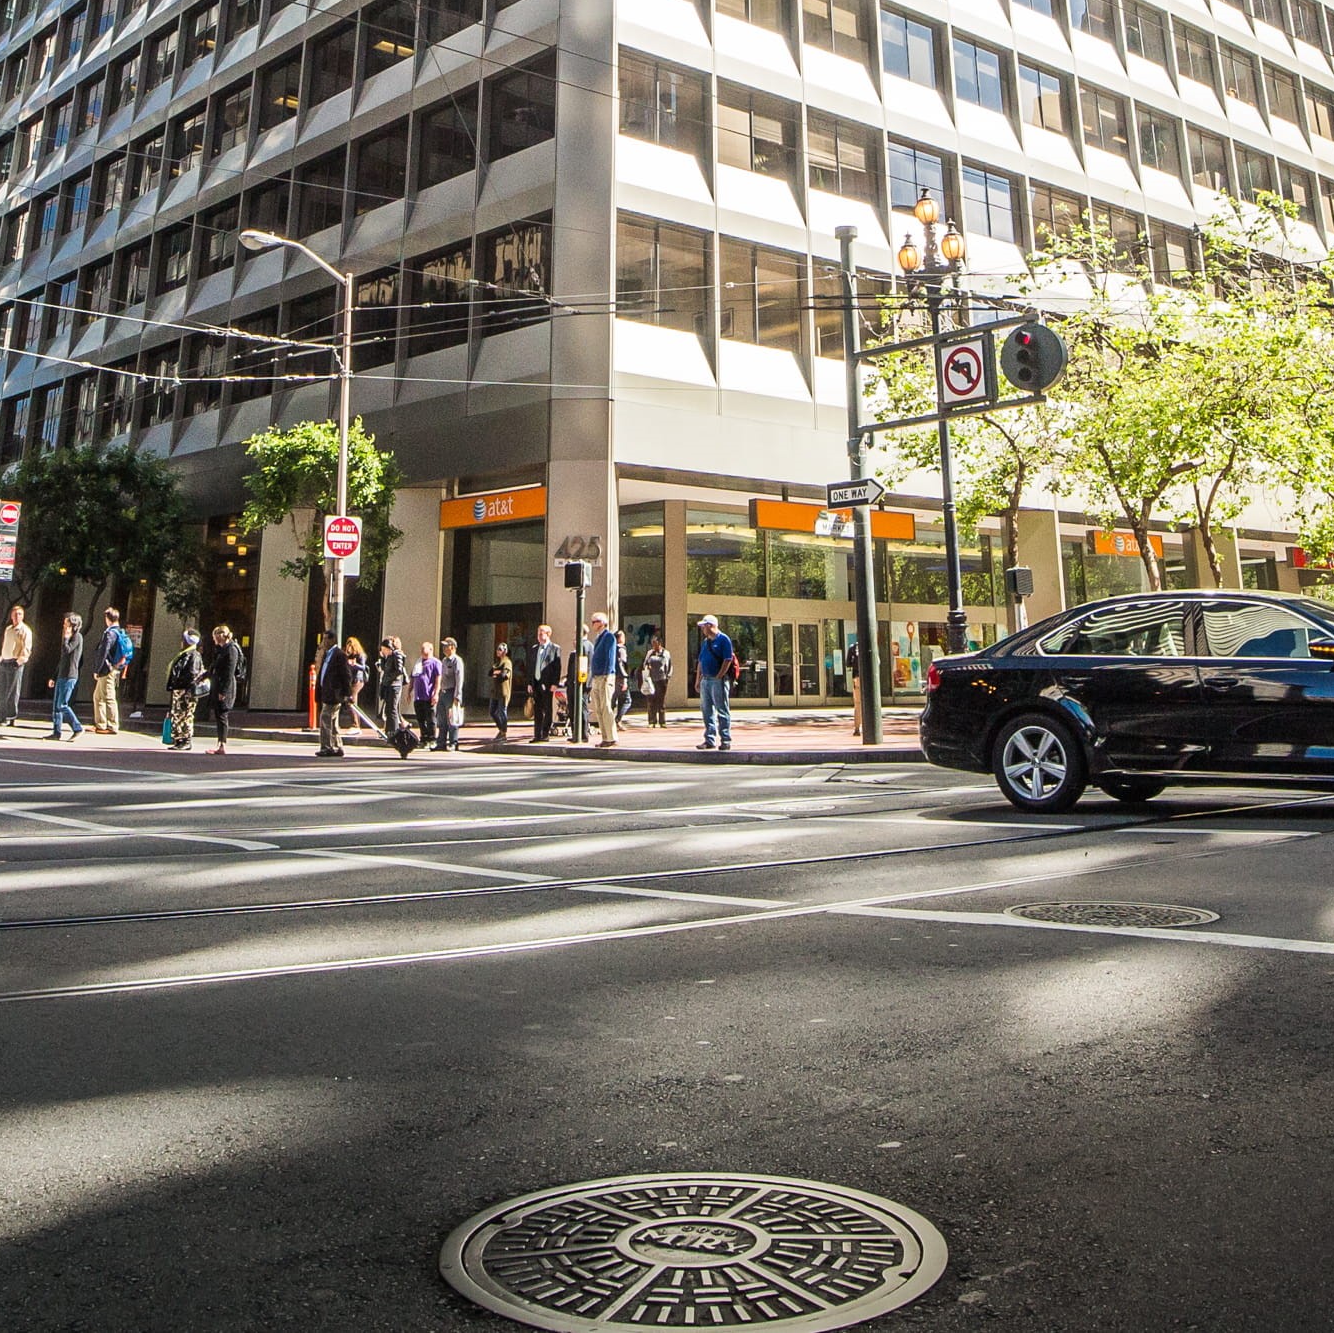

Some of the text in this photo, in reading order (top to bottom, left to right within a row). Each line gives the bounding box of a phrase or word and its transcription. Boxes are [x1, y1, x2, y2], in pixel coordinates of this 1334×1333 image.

[833, 488, 867, 501] ONE WAY
[488, 496, 514, 517] at&t
[330, 524, 340, 532] DO
[332, 542, 353, 550] ENTER
[554, 535, 602, 559] 425
